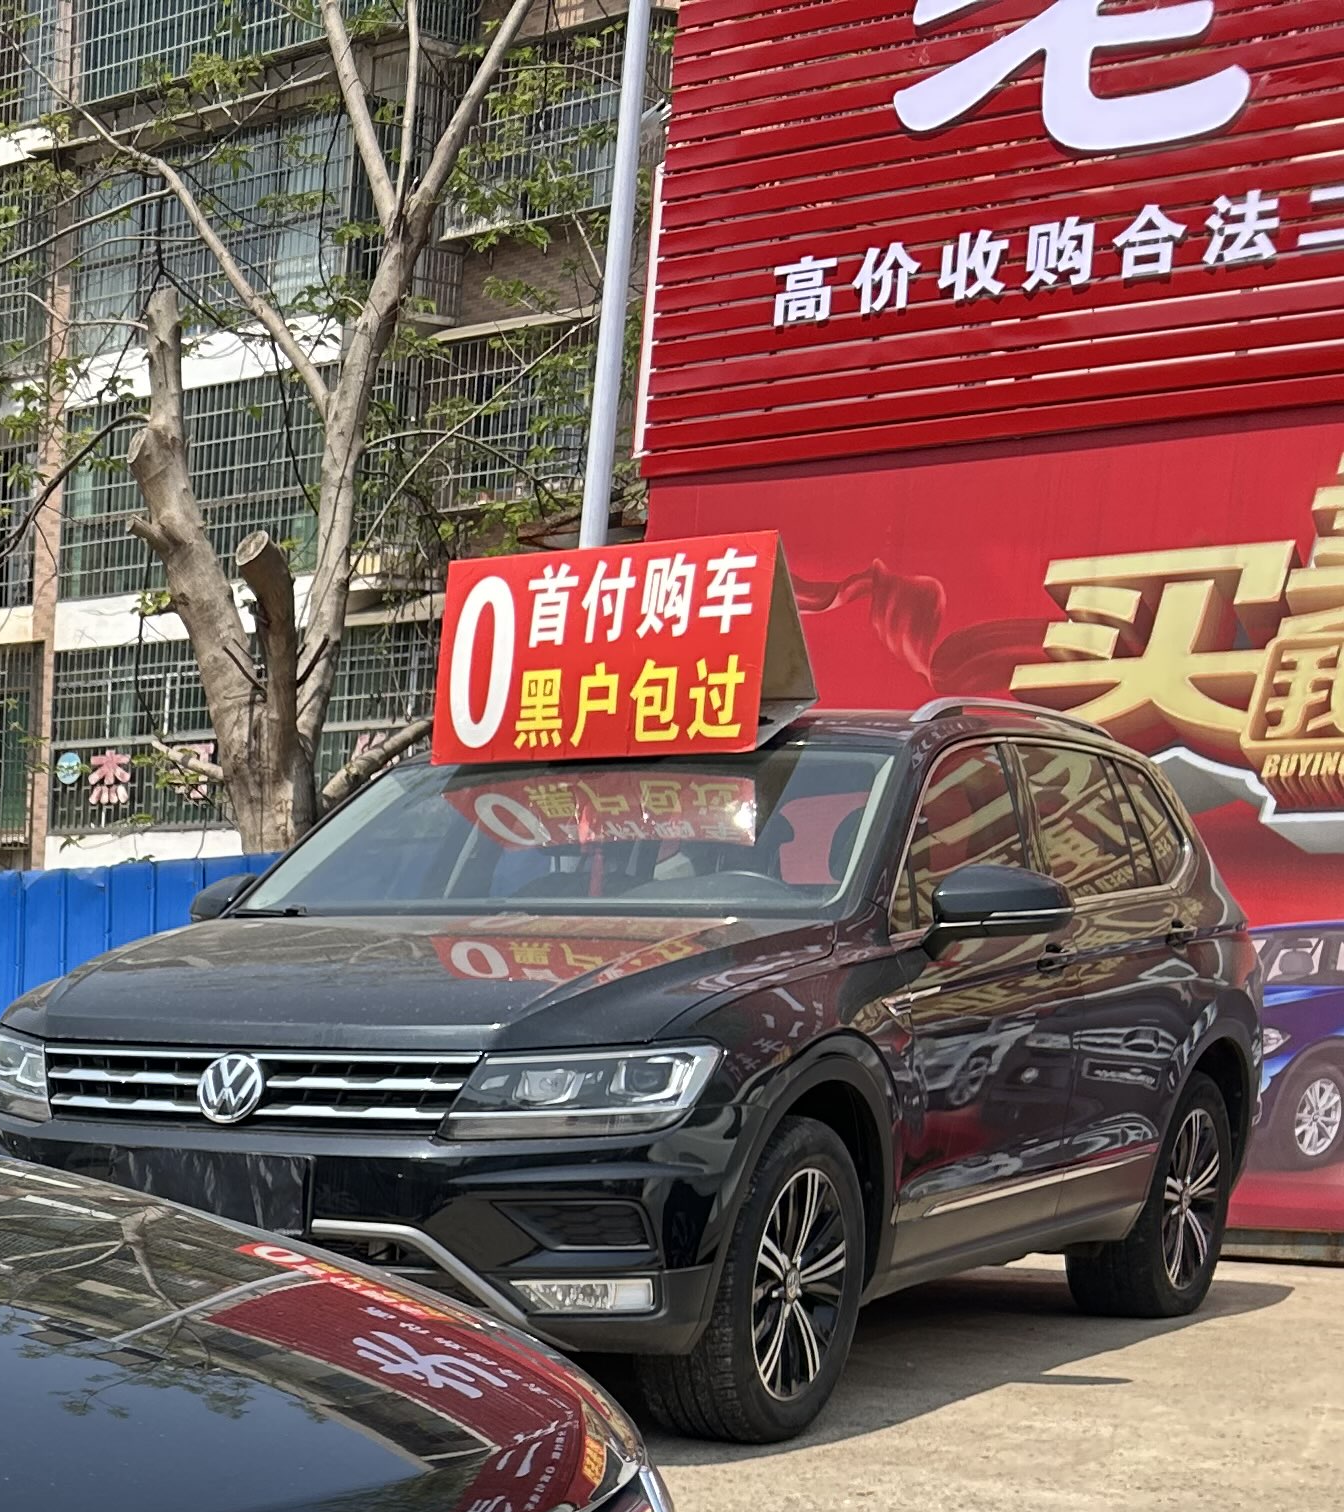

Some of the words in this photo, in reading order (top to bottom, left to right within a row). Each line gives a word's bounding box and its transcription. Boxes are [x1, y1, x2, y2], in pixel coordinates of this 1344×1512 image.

[450, 576, 515, 748] 0
[527, 548, 758, 648] 首付购车
[514, 654, 746, 749] 黑户包过
[1261, 751, 1344, 778] BUYIN
